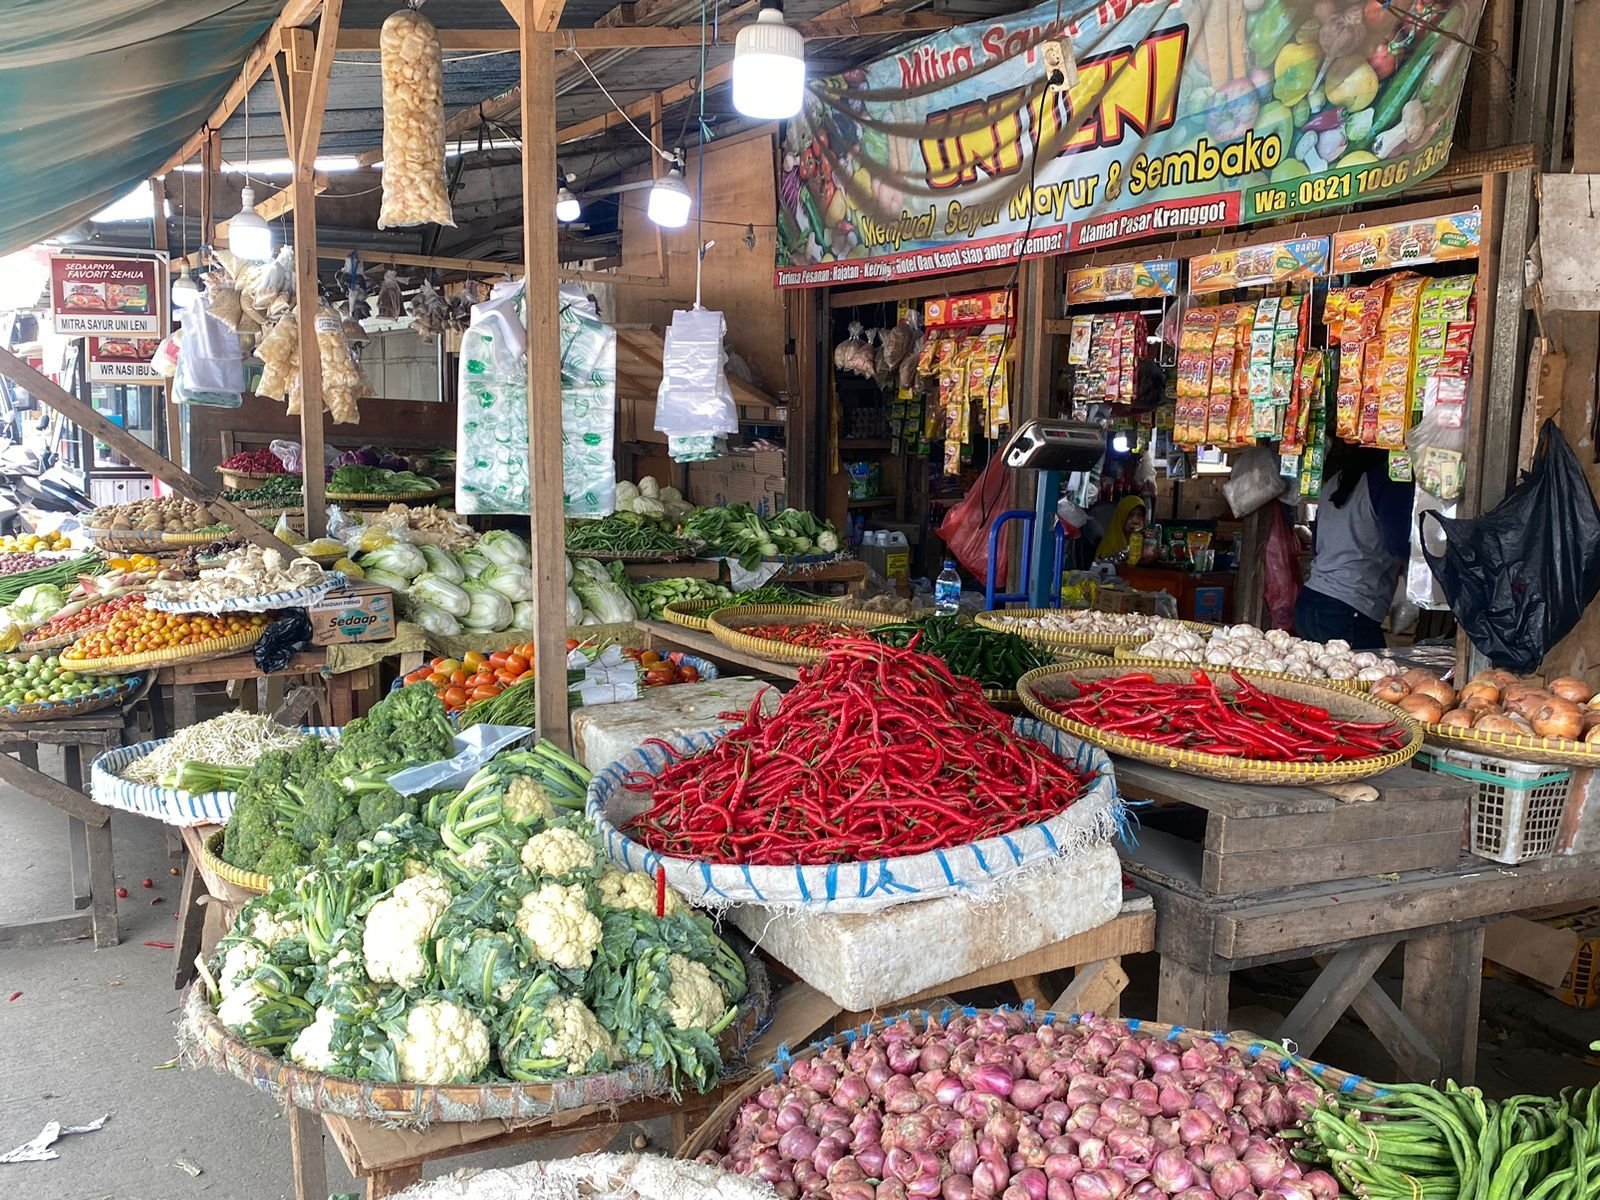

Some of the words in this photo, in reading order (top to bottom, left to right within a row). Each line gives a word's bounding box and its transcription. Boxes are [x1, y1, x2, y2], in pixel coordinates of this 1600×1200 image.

[897, 45, 975, 90] Mitra
[919, 86, 1024, 190] UNI
[861, 205, 936, 250] Menjual
[945, 200, 1002, 237] Sayur
[1008, 174, 1100, 221] Mayur
[1105, 160, 1122, 201] &
[1129, 131, 1282, 195] Sembako
[1255, 189, 1287, 213] Wa
[1299, 173, 1351, 205] 0821
[1356, 159, 1410, 193] 1086
[1078, 220, 1119, 245] Alamat
[1119, 212, 1153, 236] Pasar
[1152, 200, 1226, 229] Kranggot
[778, 270, 801, 286] Terima
[833, 264, 859, 281] Hajatan
[917, 254, 933, 271] Dan
[934, 249, 961, 268] Kapal
[962, 245, 983, 265] siap
[984, 242, 1012, 259] antar
[1362, 256, 1376, 265] 1000
[1402, 250, 1418, 259] 1000
[67, 270, 109, 279] FAVORIT
[110, 271, 144, 279] SEMUA
[61, 319, 86, 330] MITRA
[87, 319, 113, 330] SAYUR
[115, 320, 129, 330] UNI
[131, 320, 148, 331] LENI
[100, 364, 114, 375] WR
[115, 365, 135, 376] NASI
[136, 365, 149, 376] IBU
[329, 614, 378, 628] Sedaap
